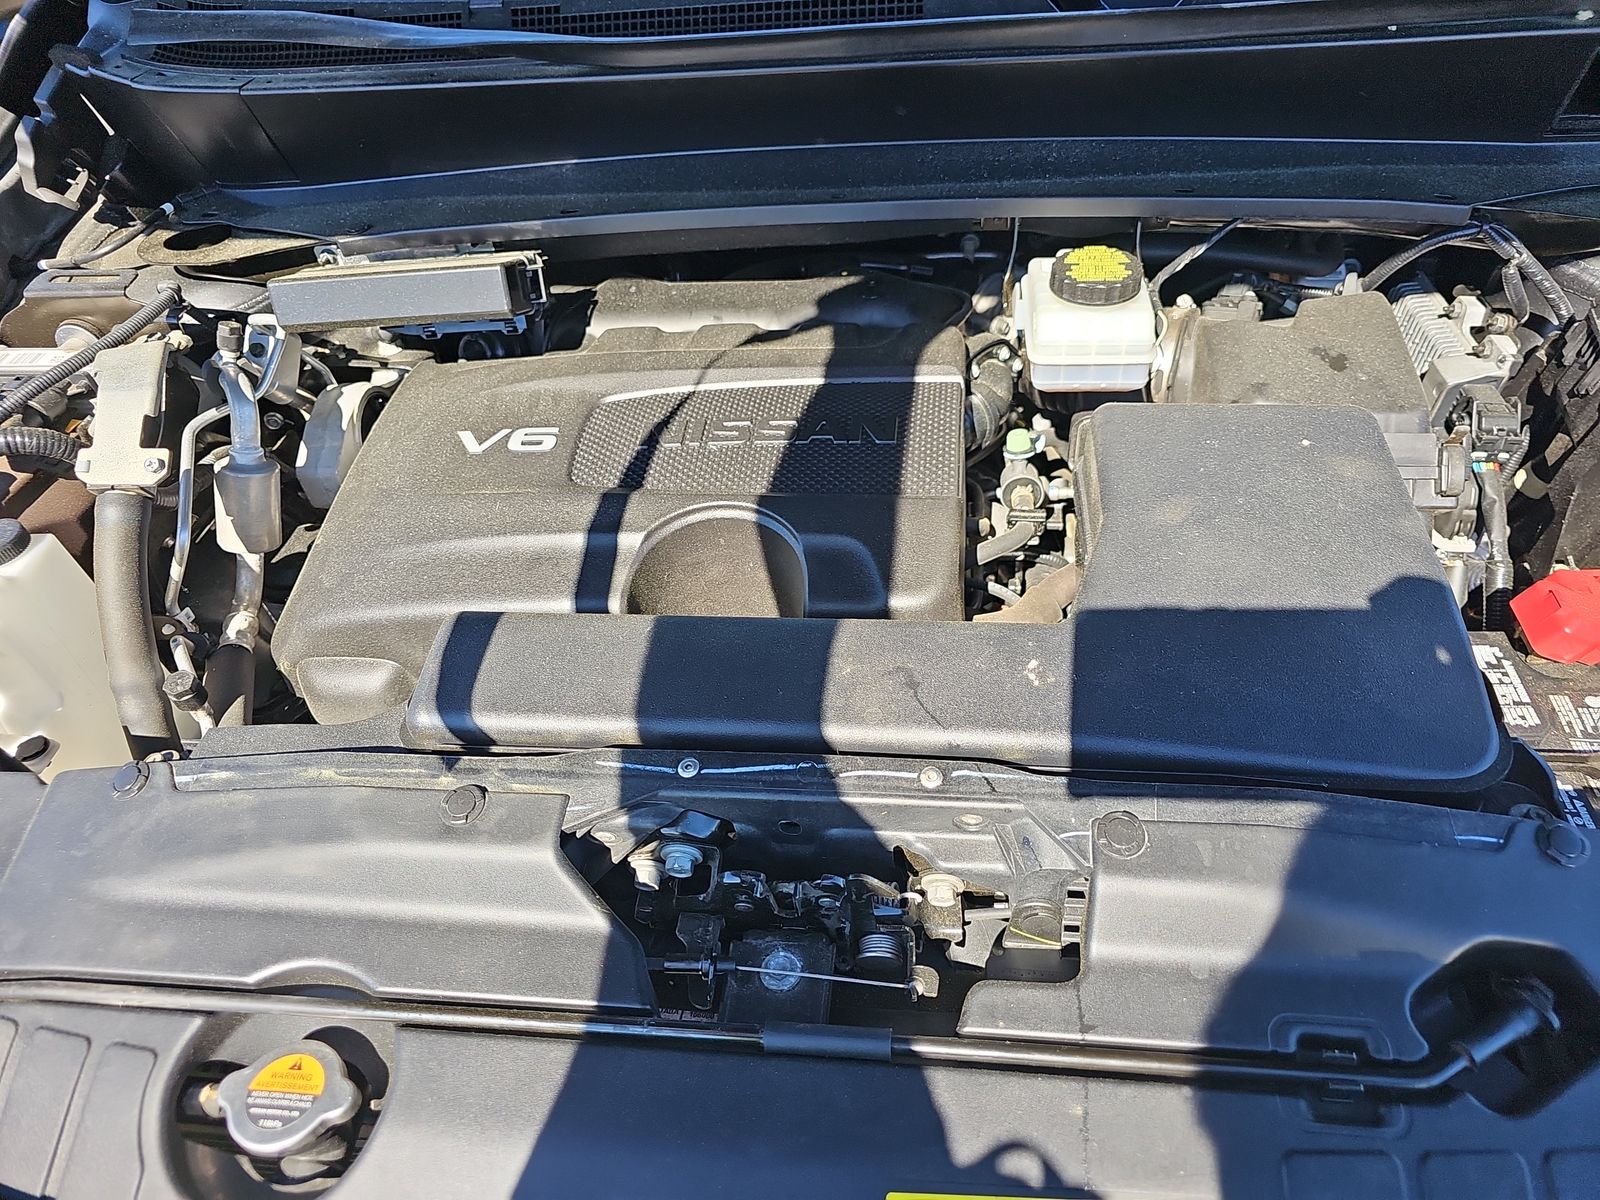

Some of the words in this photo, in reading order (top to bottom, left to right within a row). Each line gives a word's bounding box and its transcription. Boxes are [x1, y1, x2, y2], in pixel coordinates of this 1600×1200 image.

[456, 427, 561, 455] V6
[637, 416, 899, 447] NISSAN
[255, 1080, 320, 1092] AVERTISSEMENT
[270, 1071, 314, 1082] WARNING
